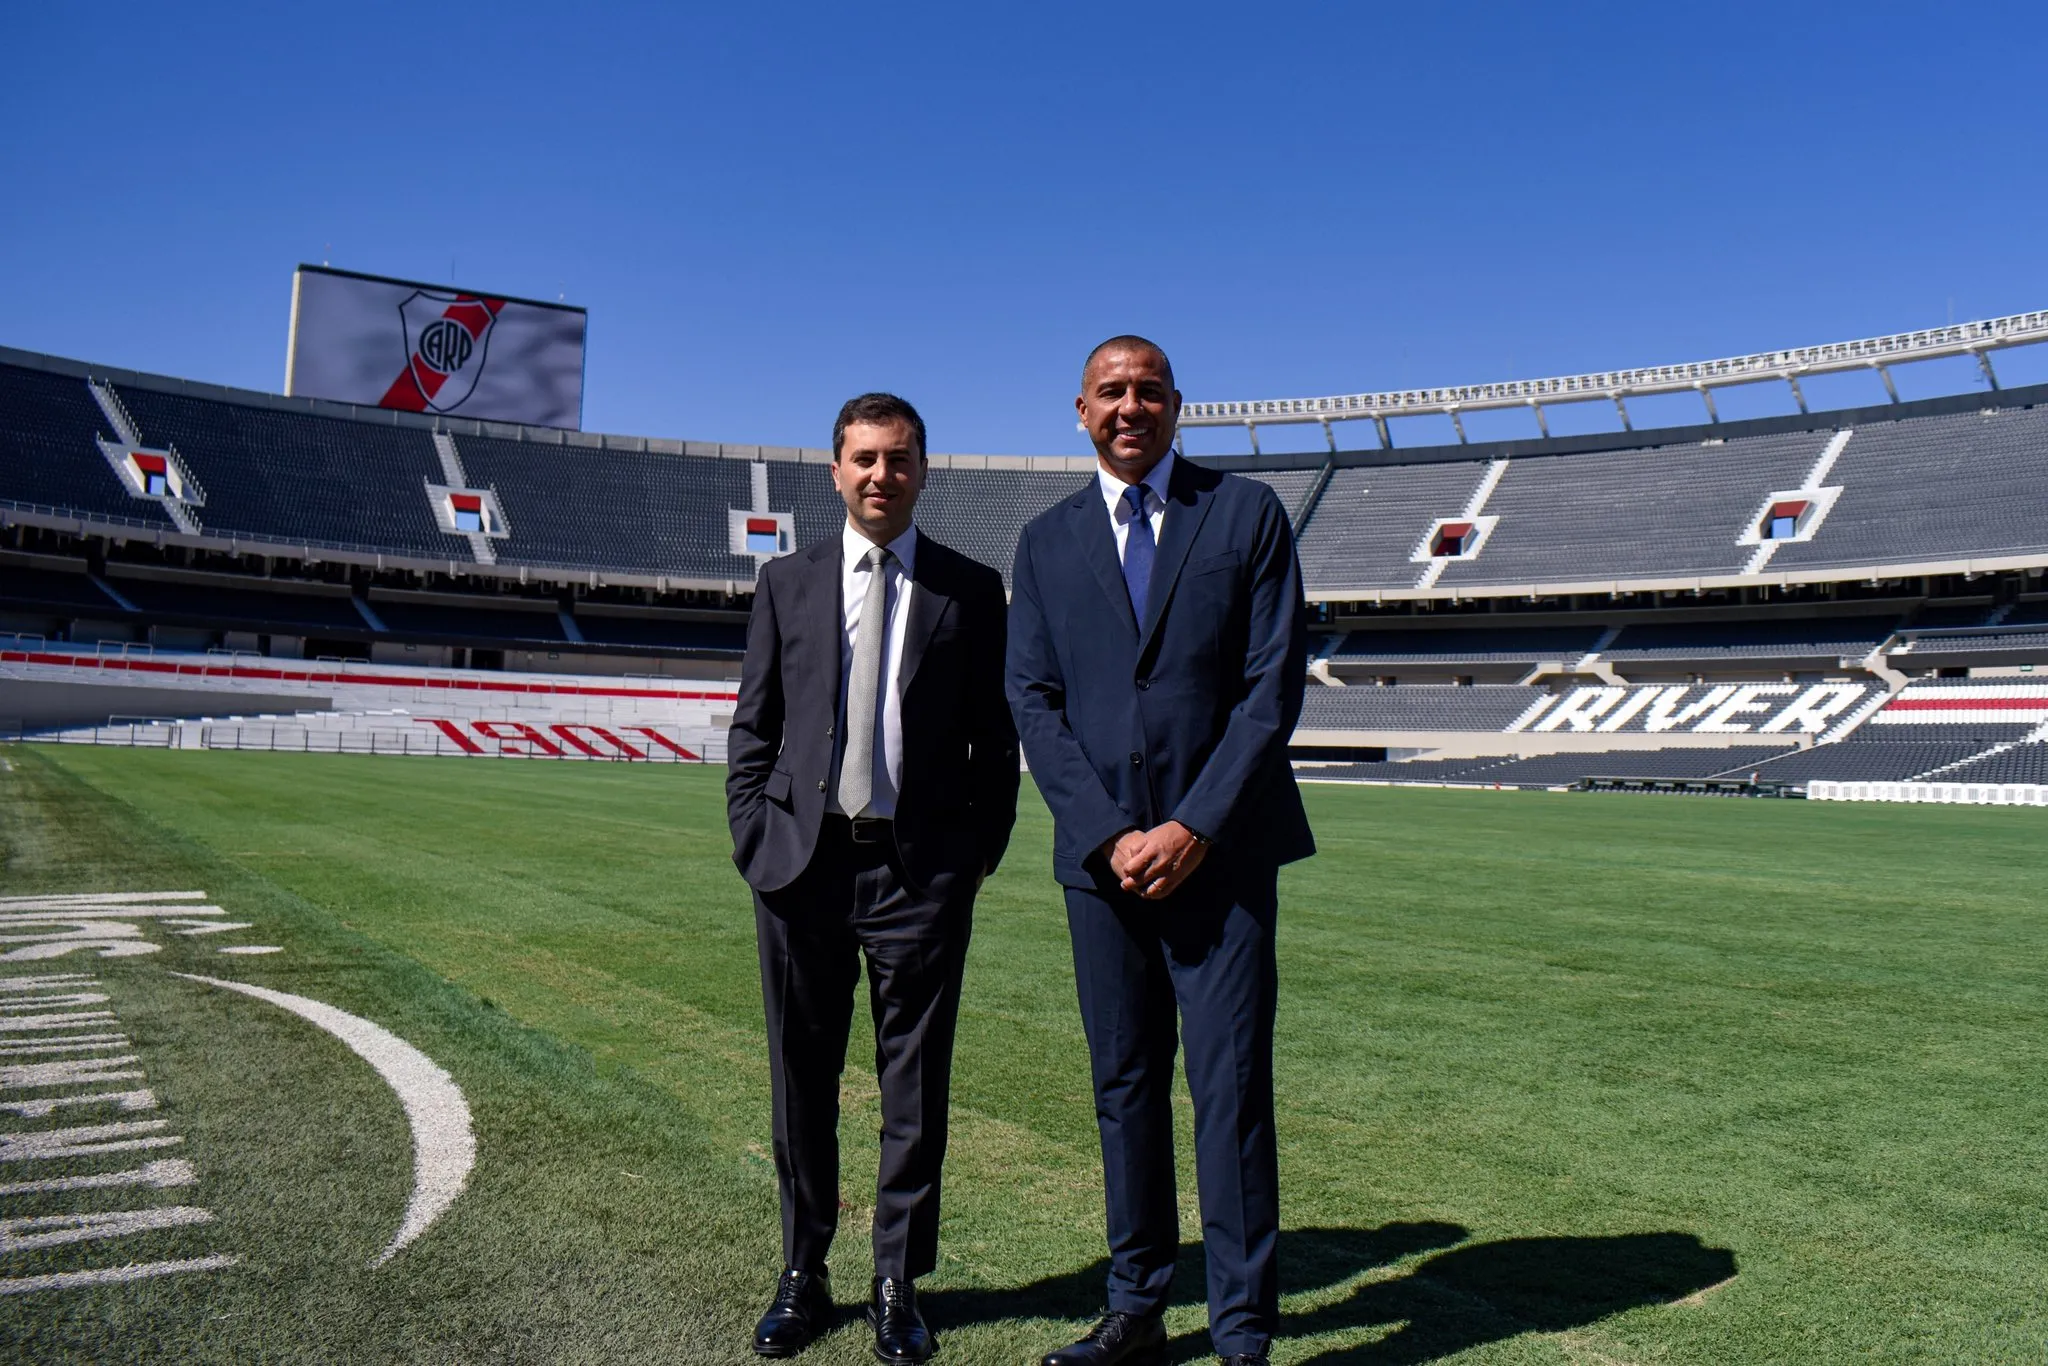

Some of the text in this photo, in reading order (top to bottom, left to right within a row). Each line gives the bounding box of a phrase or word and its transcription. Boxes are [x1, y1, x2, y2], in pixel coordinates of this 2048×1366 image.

[419, 320, 472, 372] CARP
[1533, 684, 1867, 732] RIVER
[413, 718, 702, 760] 1901
